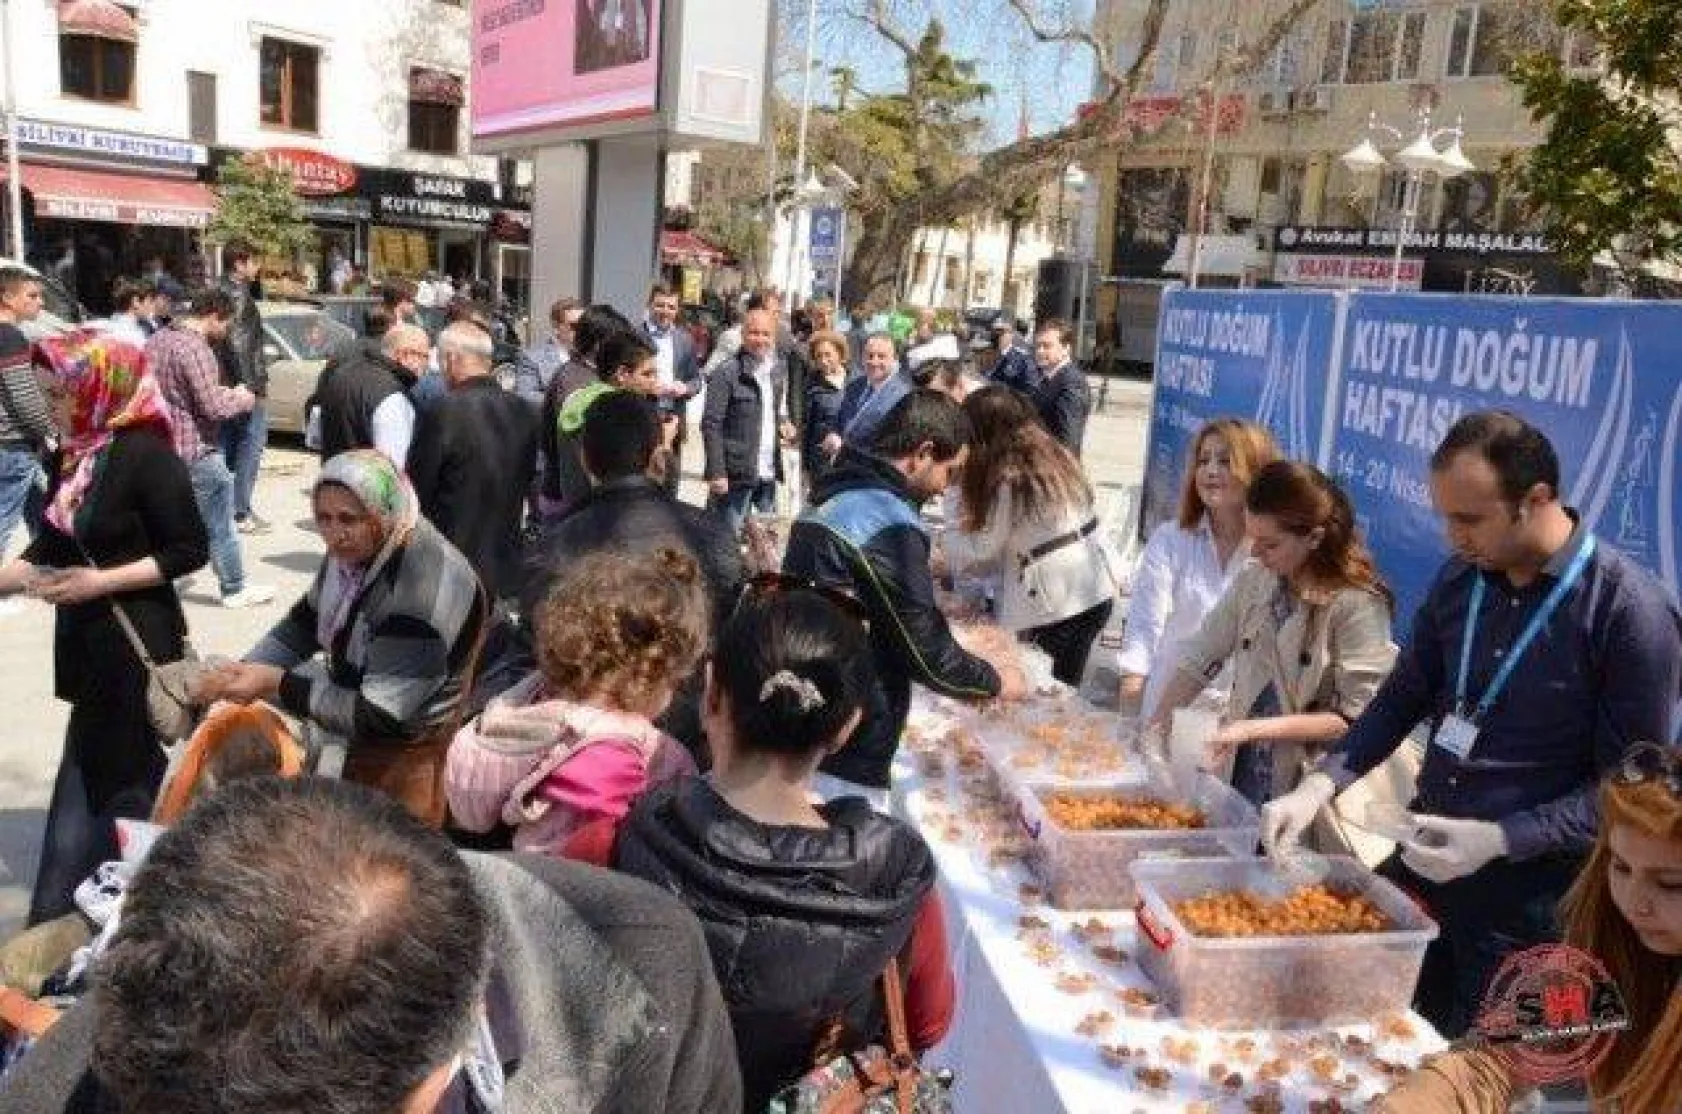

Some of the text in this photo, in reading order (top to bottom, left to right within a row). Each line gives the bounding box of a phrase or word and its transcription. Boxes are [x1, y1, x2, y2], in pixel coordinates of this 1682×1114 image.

[1302, 228, 1363, 246] Avukat
[1350, 317, 1598, 406] KUTLU DOĞUM
